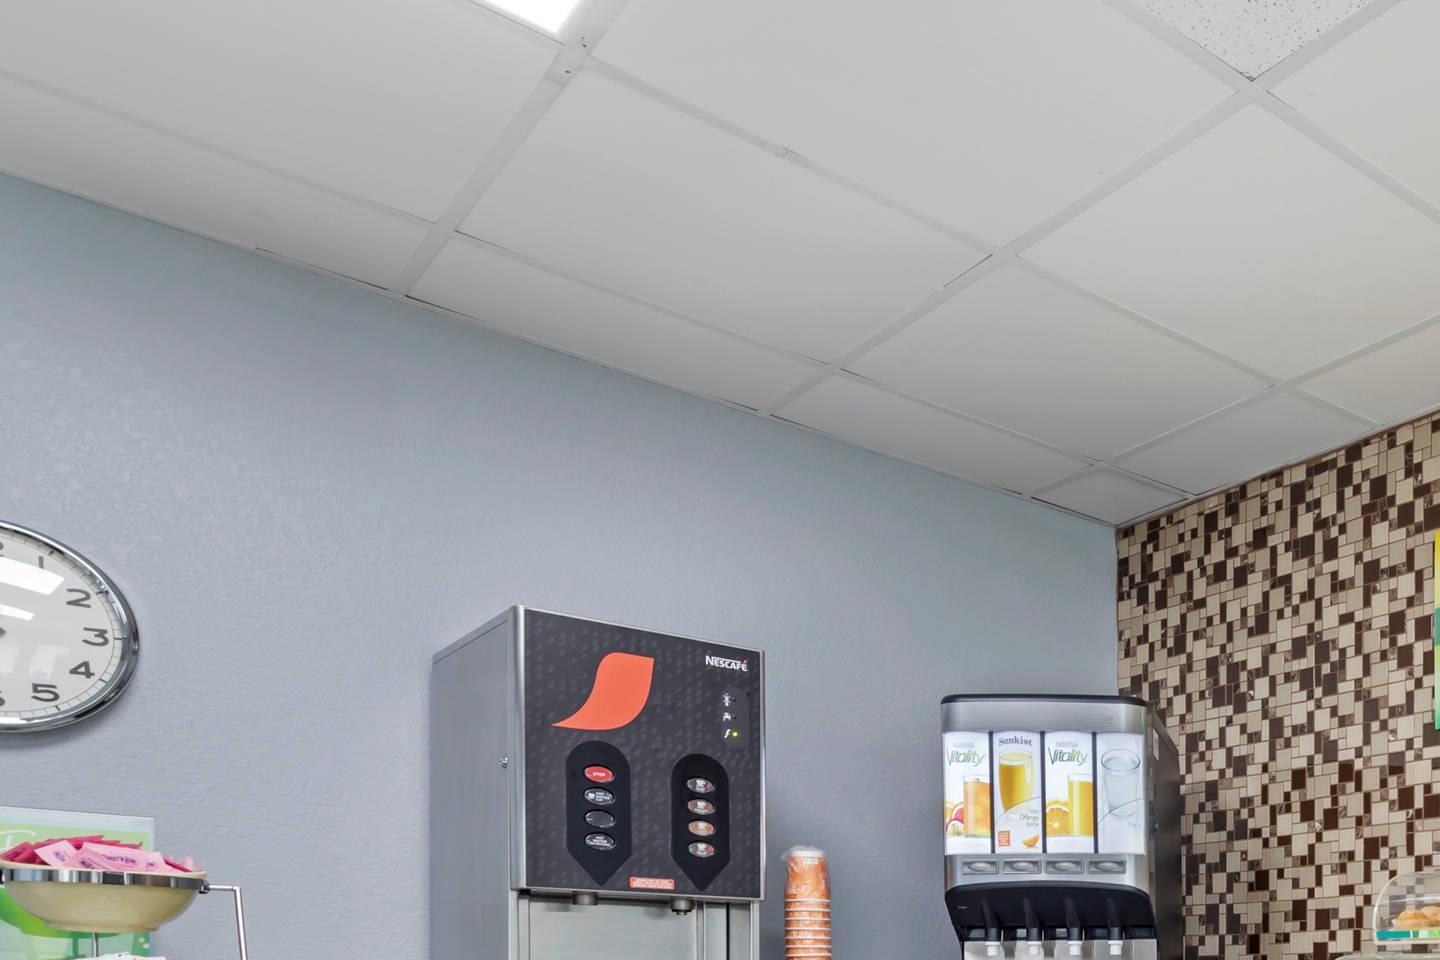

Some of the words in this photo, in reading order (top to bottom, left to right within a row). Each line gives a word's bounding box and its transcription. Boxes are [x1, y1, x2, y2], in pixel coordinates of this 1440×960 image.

[66, 588, 91, 608] 2
[82, 627, 109, 647] 3
[69, 660, 95, 679] 4
[31, 683, 60, 702] 5
[999, 735, 1033, 746] Sunkist
[946, 747, 985, 767] Vitality
[1048, 746, 1089, 767] Vitality
